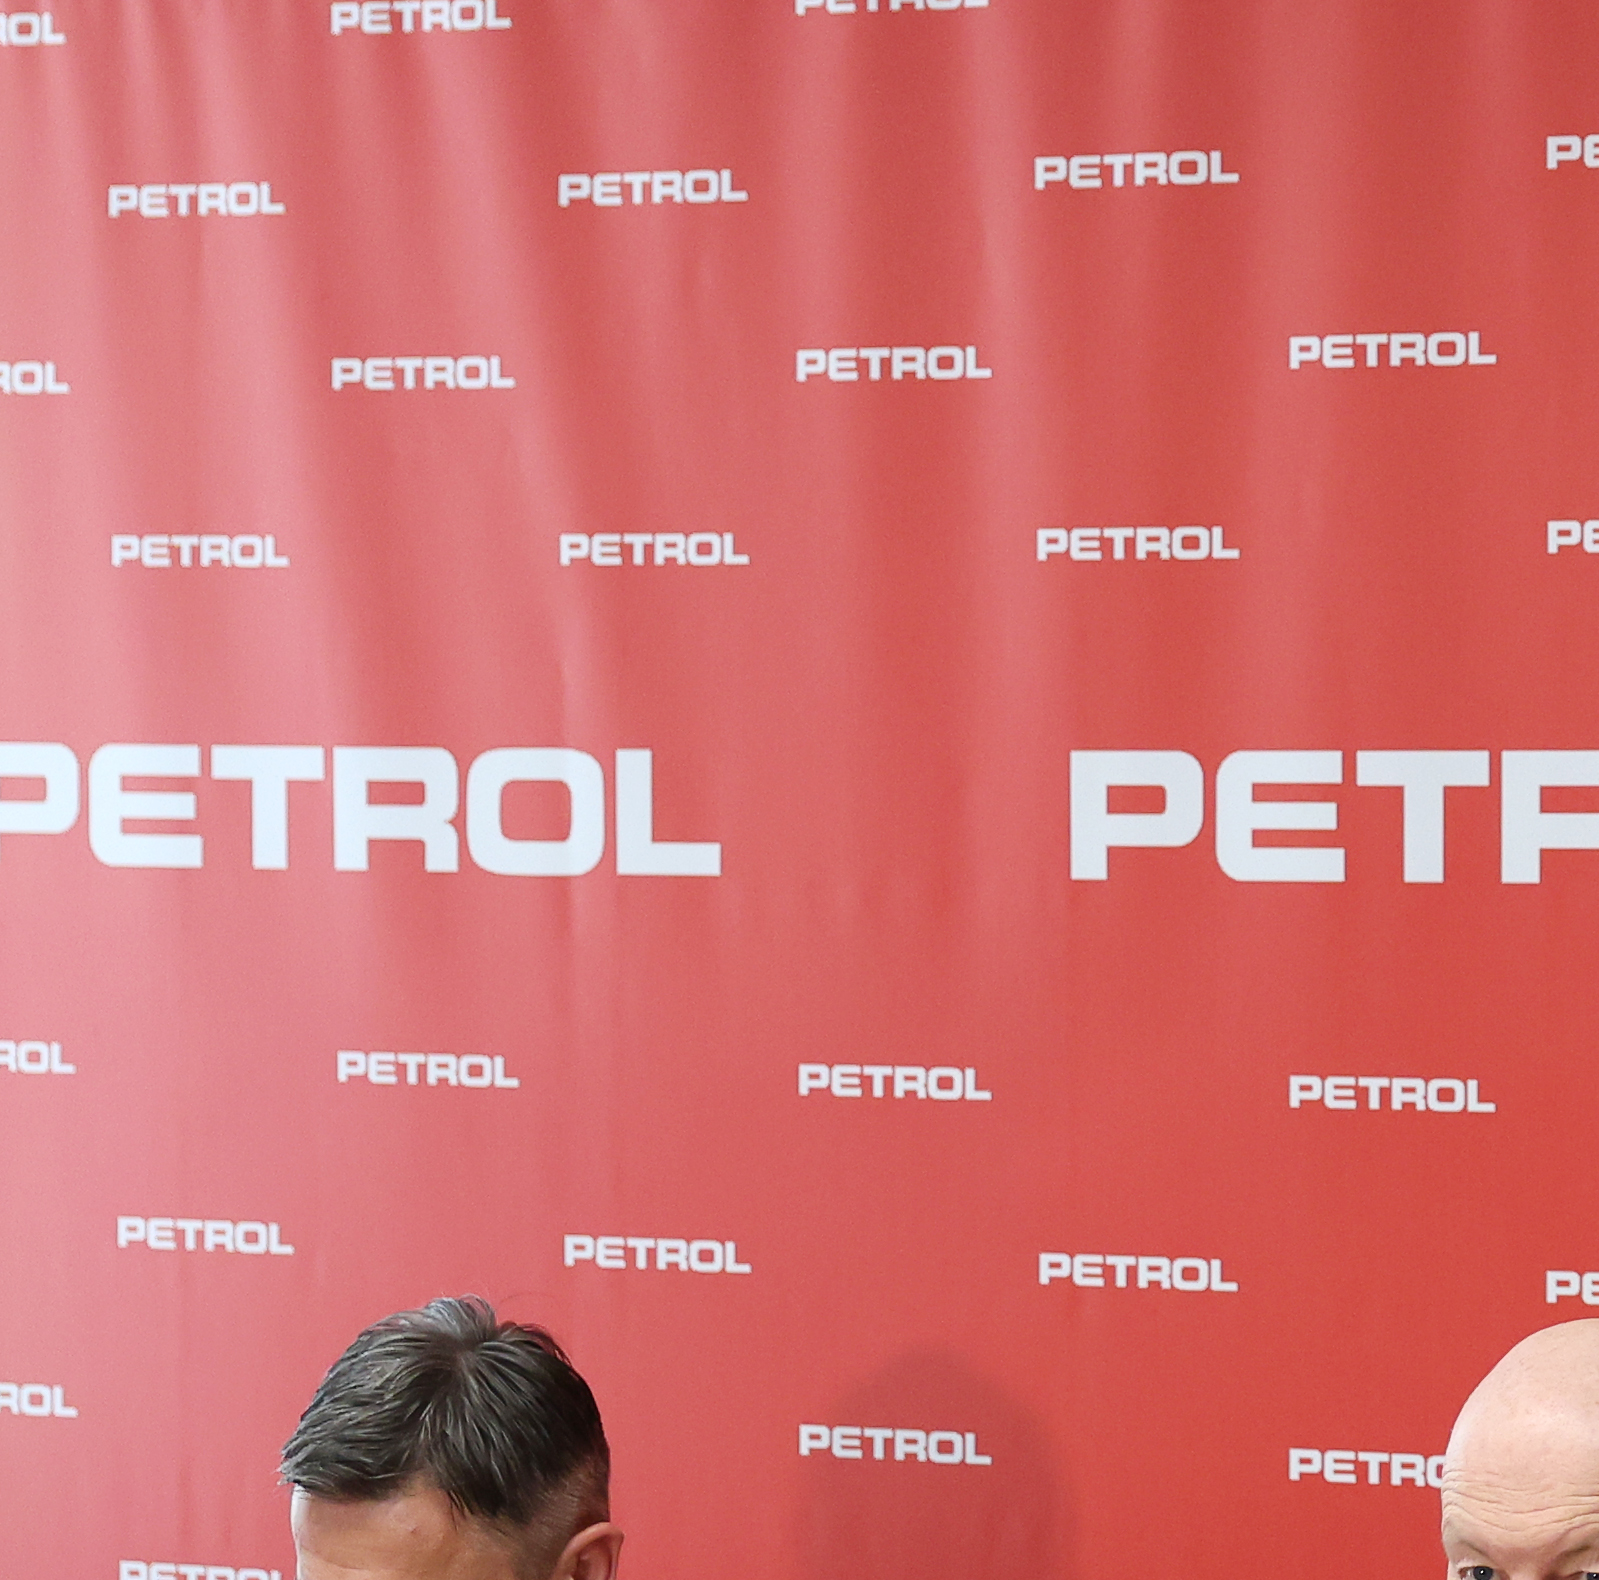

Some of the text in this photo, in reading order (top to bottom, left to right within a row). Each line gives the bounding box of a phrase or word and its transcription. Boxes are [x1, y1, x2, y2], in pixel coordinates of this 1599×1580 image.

[331, 0, 511, 34] PETROL
[558, 169, 748, 207] PETROL
[1034, 151, 1239, 190] PETROL
[109, 182, 284, 217] PETROL
[796, 346, 992, 382] PETROL
[1289, 332, 1497, 369] PETROL
[331, 355, 518, 391] PETROL
[112, 535, 289, 567] PETROL
[559, 532, 750, 567] PETROL
[1036, 526, 1240, 561] PETROL
[0, 1040, 75, 1073] ROL
[336, 1050, 521, 1088] PETROL
[798, 1063, 992, 1100] PETROL
[1289, 1075, 1496, 1112] PETROL
[118, 1217, 294, 1254] PETROL
[564, 1235, 752, 1273] PETROL
[1039, 1253, 1238, 1292] PETROL
[0, 1383, 78, 1417] ROL
[799, 1424, 992, 1465] PETROL
[1289, 1448, 1445, 1488] PETR
